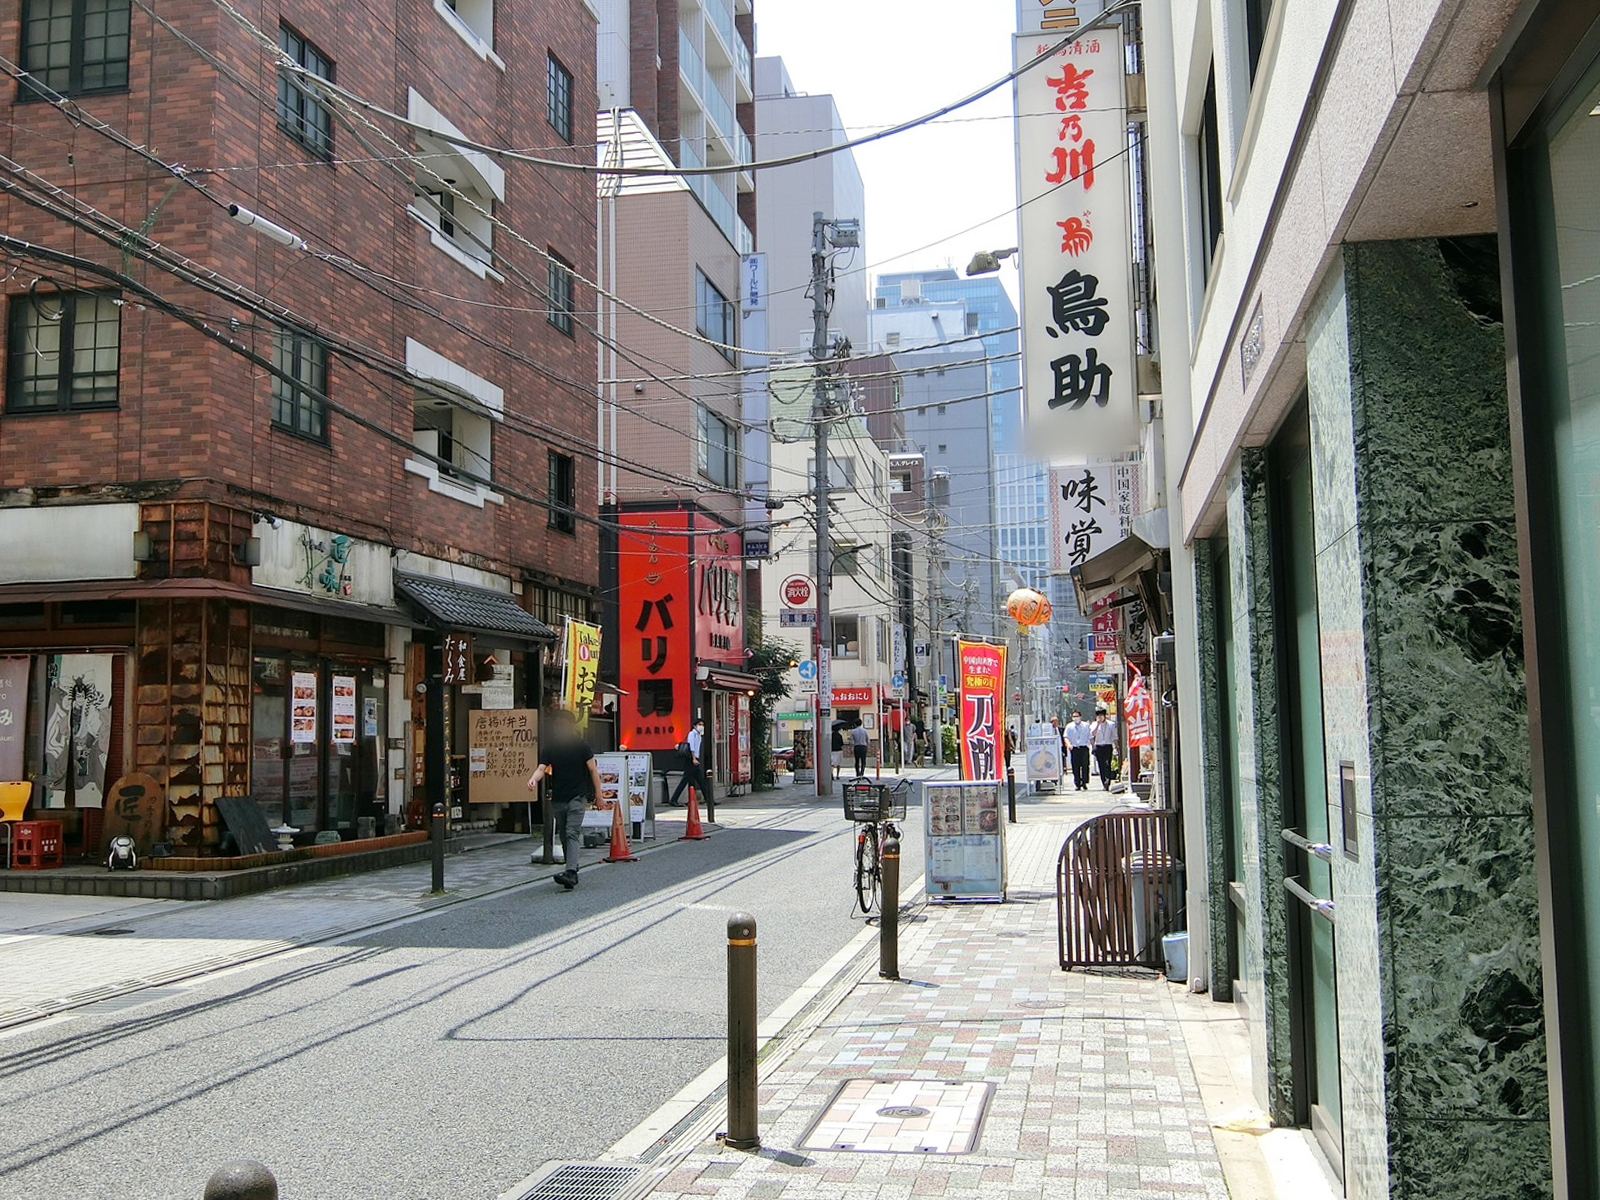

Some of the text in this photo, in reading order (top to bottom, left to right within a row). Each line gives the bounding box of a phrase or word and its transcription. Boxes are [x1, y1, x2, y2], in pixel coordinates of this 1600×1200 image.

[1046, 63, 1095, 192] 吉乃川
[1046, 269, 1113, 411] 鳥助
[1061, 469, 1106, 565] 味覚
[787, 587, 809, 597] 消火栓
[444, 634, 455, 683] たくみ
[635, 593, 674, 718] バリ男
[475, 715, 528, 729] 唐揚げ弁当
[636, 727, 675, 735] BARIO
